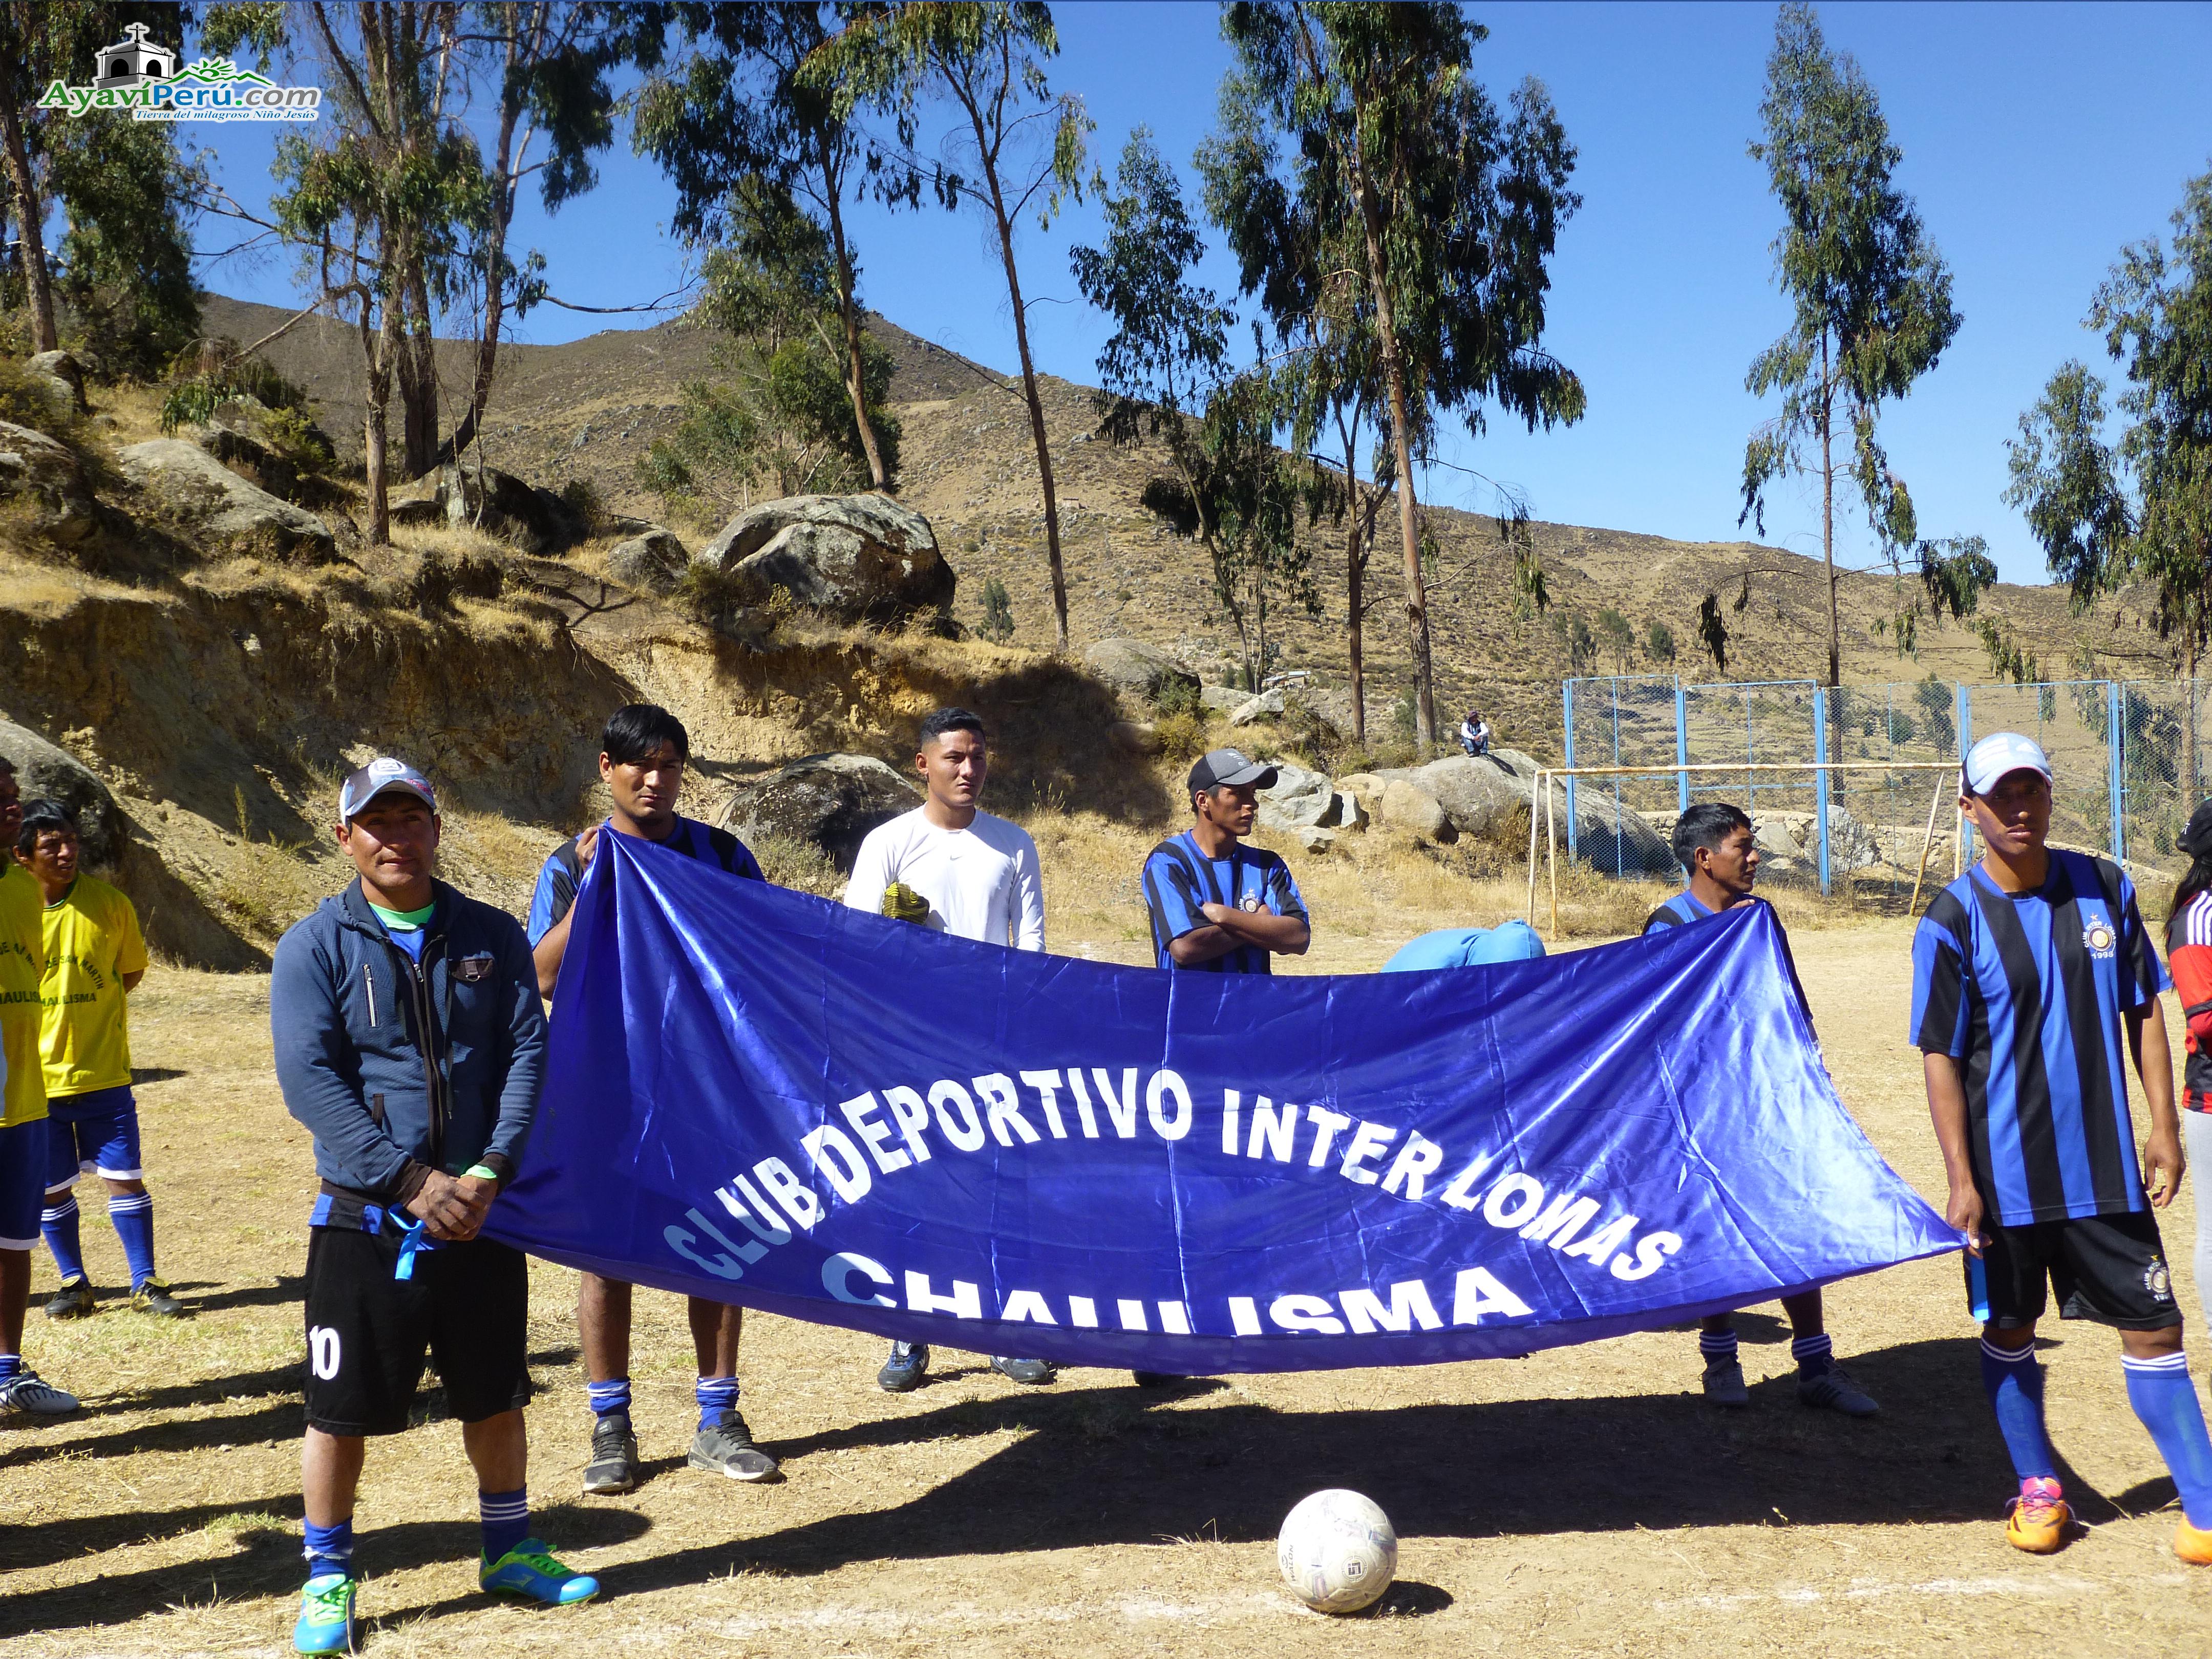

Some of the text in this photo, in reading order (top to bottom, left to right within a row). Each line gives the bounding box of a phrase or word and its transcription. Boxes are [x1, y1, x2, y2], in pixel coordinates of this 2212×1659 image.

[59, 955, 78, 965] SAN
[79, 959, 104, 990] MARTIN
[663, 1068, 1682, 1281] CLUB DEPORTIVO INTER LOMAS
[309, 1325, 341, 1380] 10
